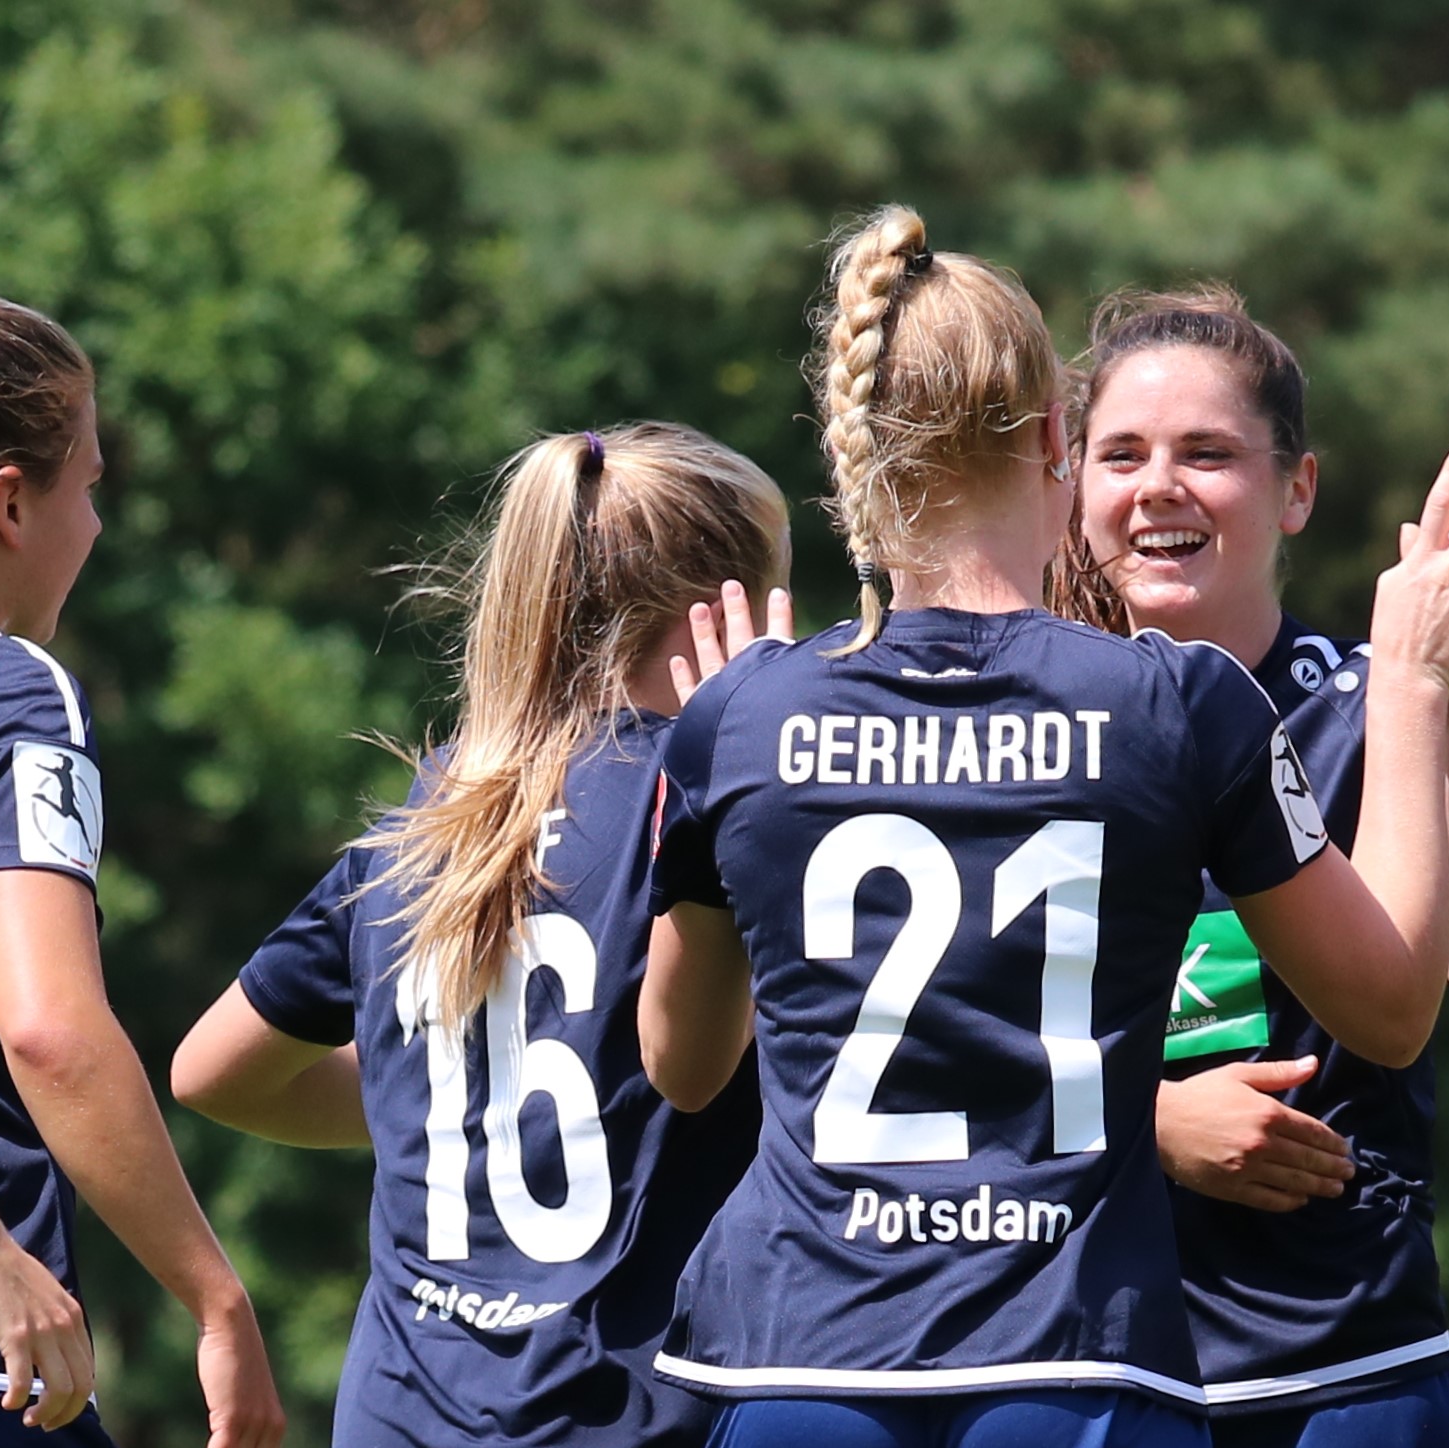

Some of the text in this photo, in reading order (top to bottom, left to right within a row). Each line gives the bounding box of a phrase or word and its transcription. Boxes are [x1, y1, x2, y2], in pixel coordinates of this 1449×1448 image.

[778, 710, 1111, 785] GERHARDT
[396, 912, 613, 1263] 16
[803, 813, 1107, 1164] 21
[843, 1184, 1073, 1243] Potsdam
